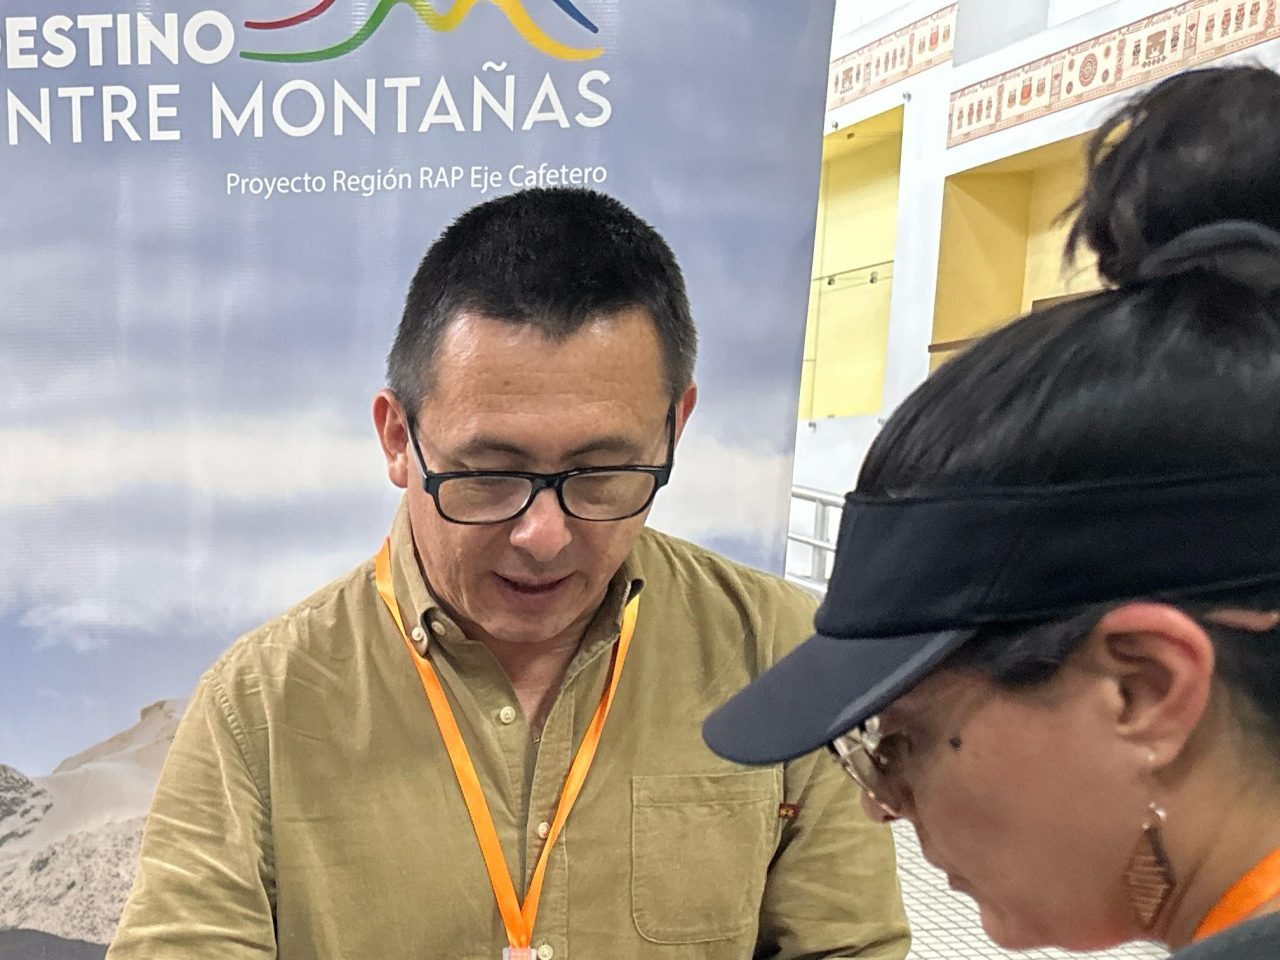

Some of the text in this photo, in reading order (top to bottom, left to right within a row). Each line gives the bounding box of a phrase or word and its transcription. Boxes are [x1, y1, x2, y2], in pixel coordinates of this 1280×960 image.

[211, 61, 613, 140] MONTAÑAS
[226, 162, 608, 197] Proyecto Región RAP Eje Cafetero
